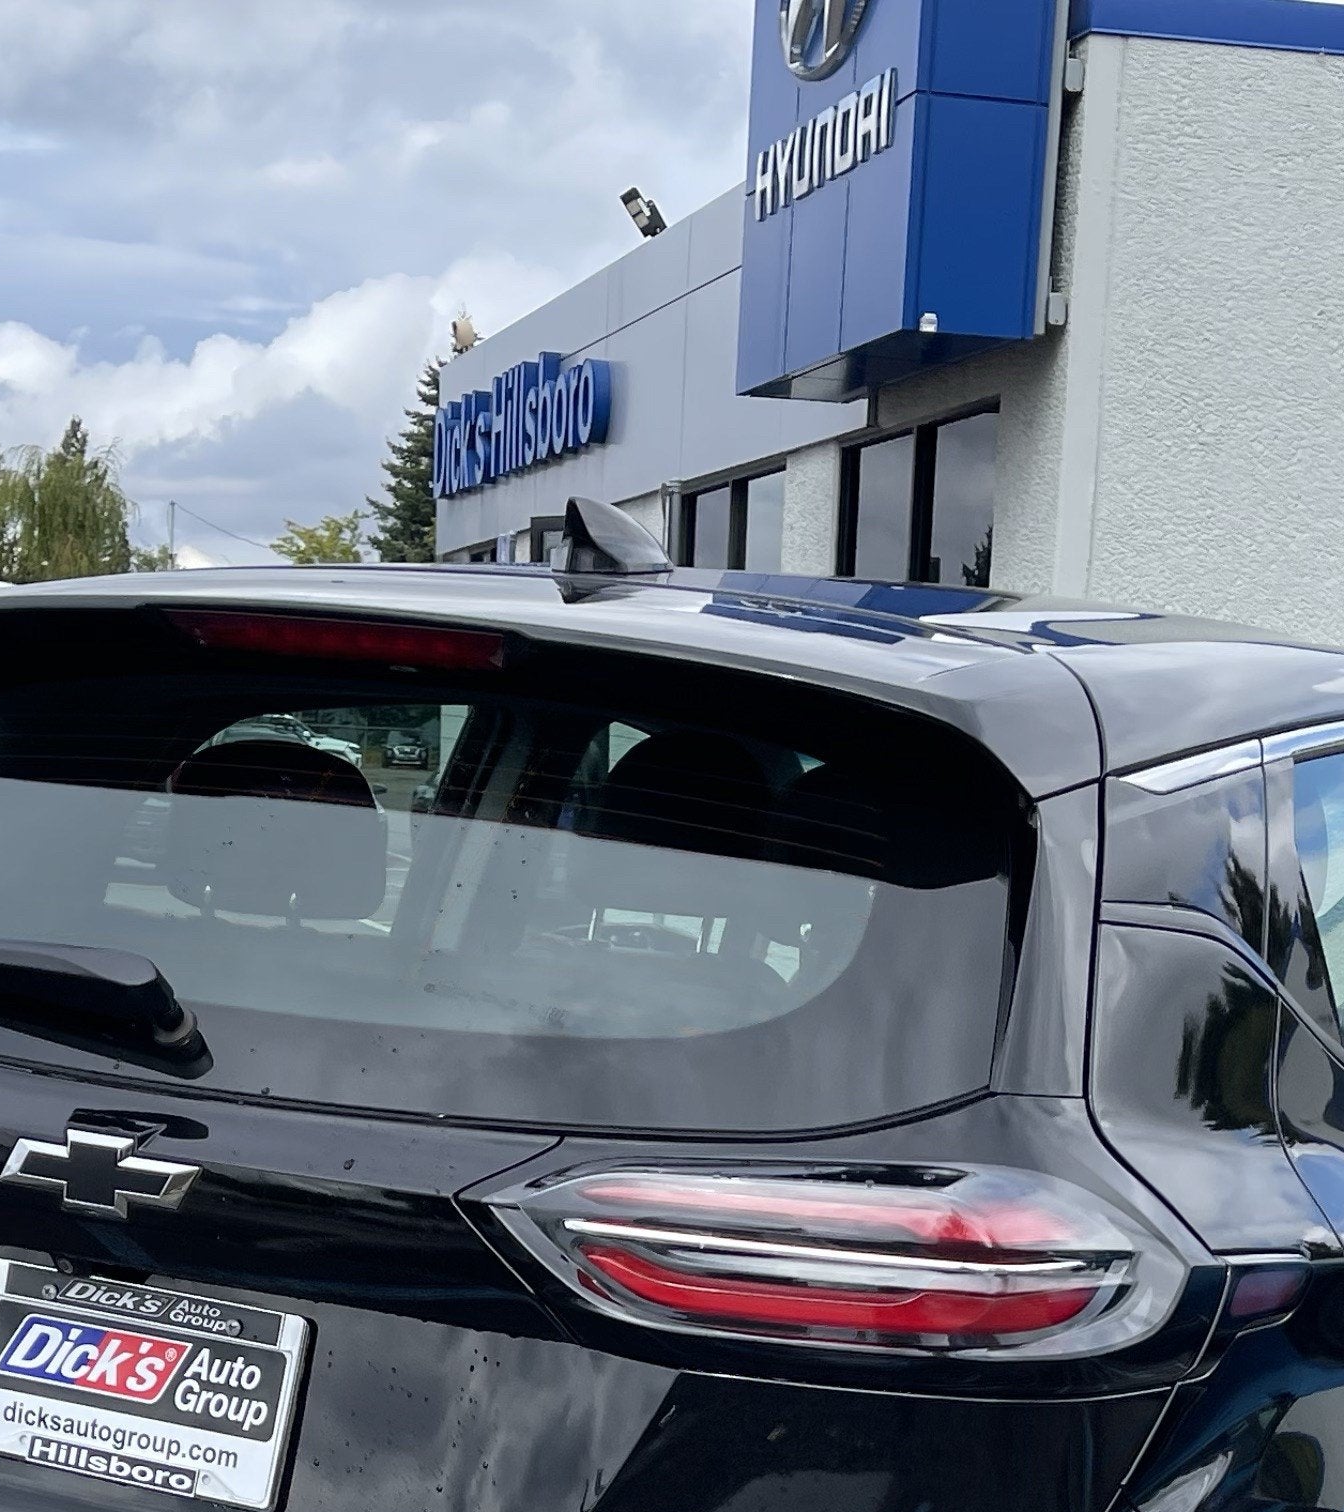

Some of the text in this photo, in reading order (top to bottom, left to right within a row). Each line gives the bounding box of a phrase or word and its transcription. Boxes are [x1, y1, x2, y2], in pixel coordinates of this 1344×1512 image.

[756, 67, 896, 221] HYUNDAI
[433, 351, 598, 499] Dick's Hillsboro
[65, 1282, 162, 1313] Dick's
[169, 1309, 227, 1332] Group
[175, 1299, 221, 1318] Auto
[184, 1347, 262, 1390] Auto
[174, 1377, 269, 1431] Group
[3, 1400, 238, 1469] dicksautogroup.com
[30, 1438, 193, 1491] Hillsboro
